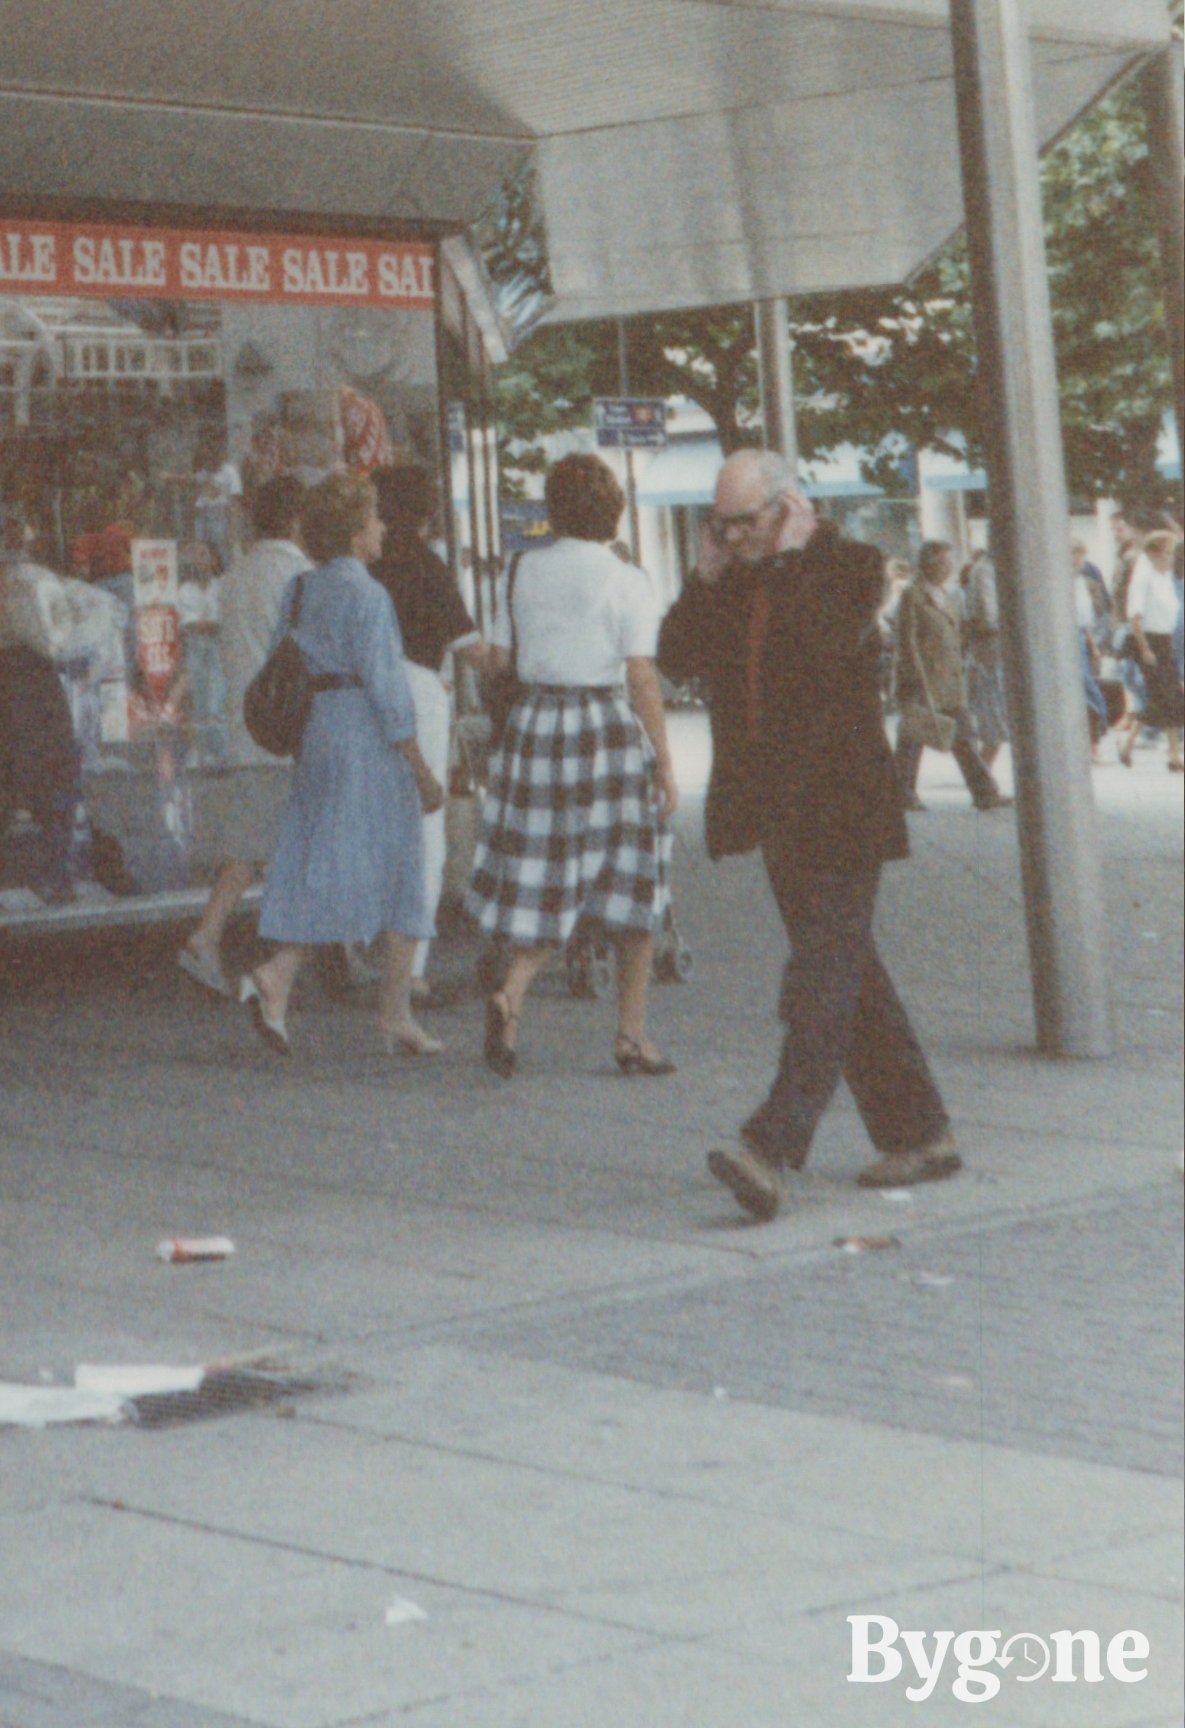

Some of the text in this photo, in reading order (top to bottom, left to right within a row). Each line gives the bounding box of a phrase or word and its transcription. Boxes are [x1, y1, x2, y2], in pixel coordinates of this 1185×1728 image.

[73, 236, 166, 288] SALE
[180, 241, 270, 292] SALE
[282, 248, 369, 296] SALE
